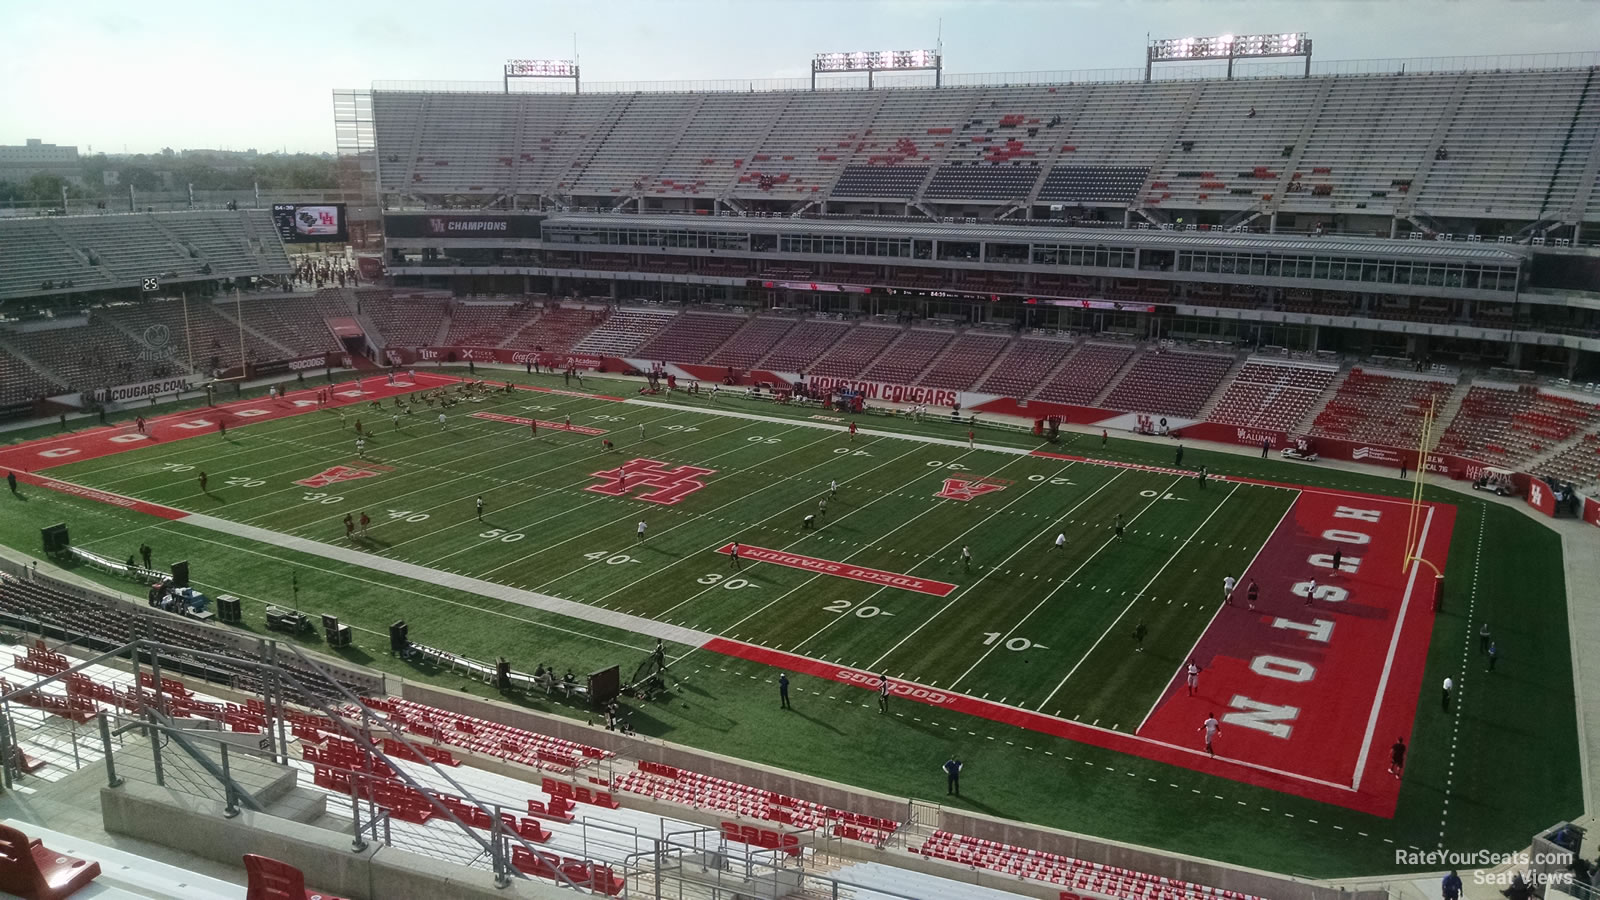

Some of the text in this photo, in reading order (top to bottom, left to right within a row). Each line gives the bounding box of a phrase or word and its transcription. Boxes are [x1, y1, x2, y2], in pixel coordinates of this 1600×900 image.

[448, 221, 507, 231] CHAMPIONS
[144, 278, 157, 290] 25
[136, 345, 178, 362] Allstate
[420, 349, 438, 360] Lite
[575, 358, 600, 367] Academy
[97, 379, 186, 402] UCOUGARS.COM
[882, 384, 957, 407] COUGARS
[1246, 433, 1277, 444] ALUMNI
[389, 509, 430, 523] 40
[479, 528, 525, 543] 50
[584, 551, 632, 565] 40
[746, 548, 923, 589] TDECU STADIUM
[697, 573, 748, 590] 30
[823, 600, 881, 618] 20
[1220, 505, 1383, 740] HOUSTON
[982, 631, 1031, 651] 10
